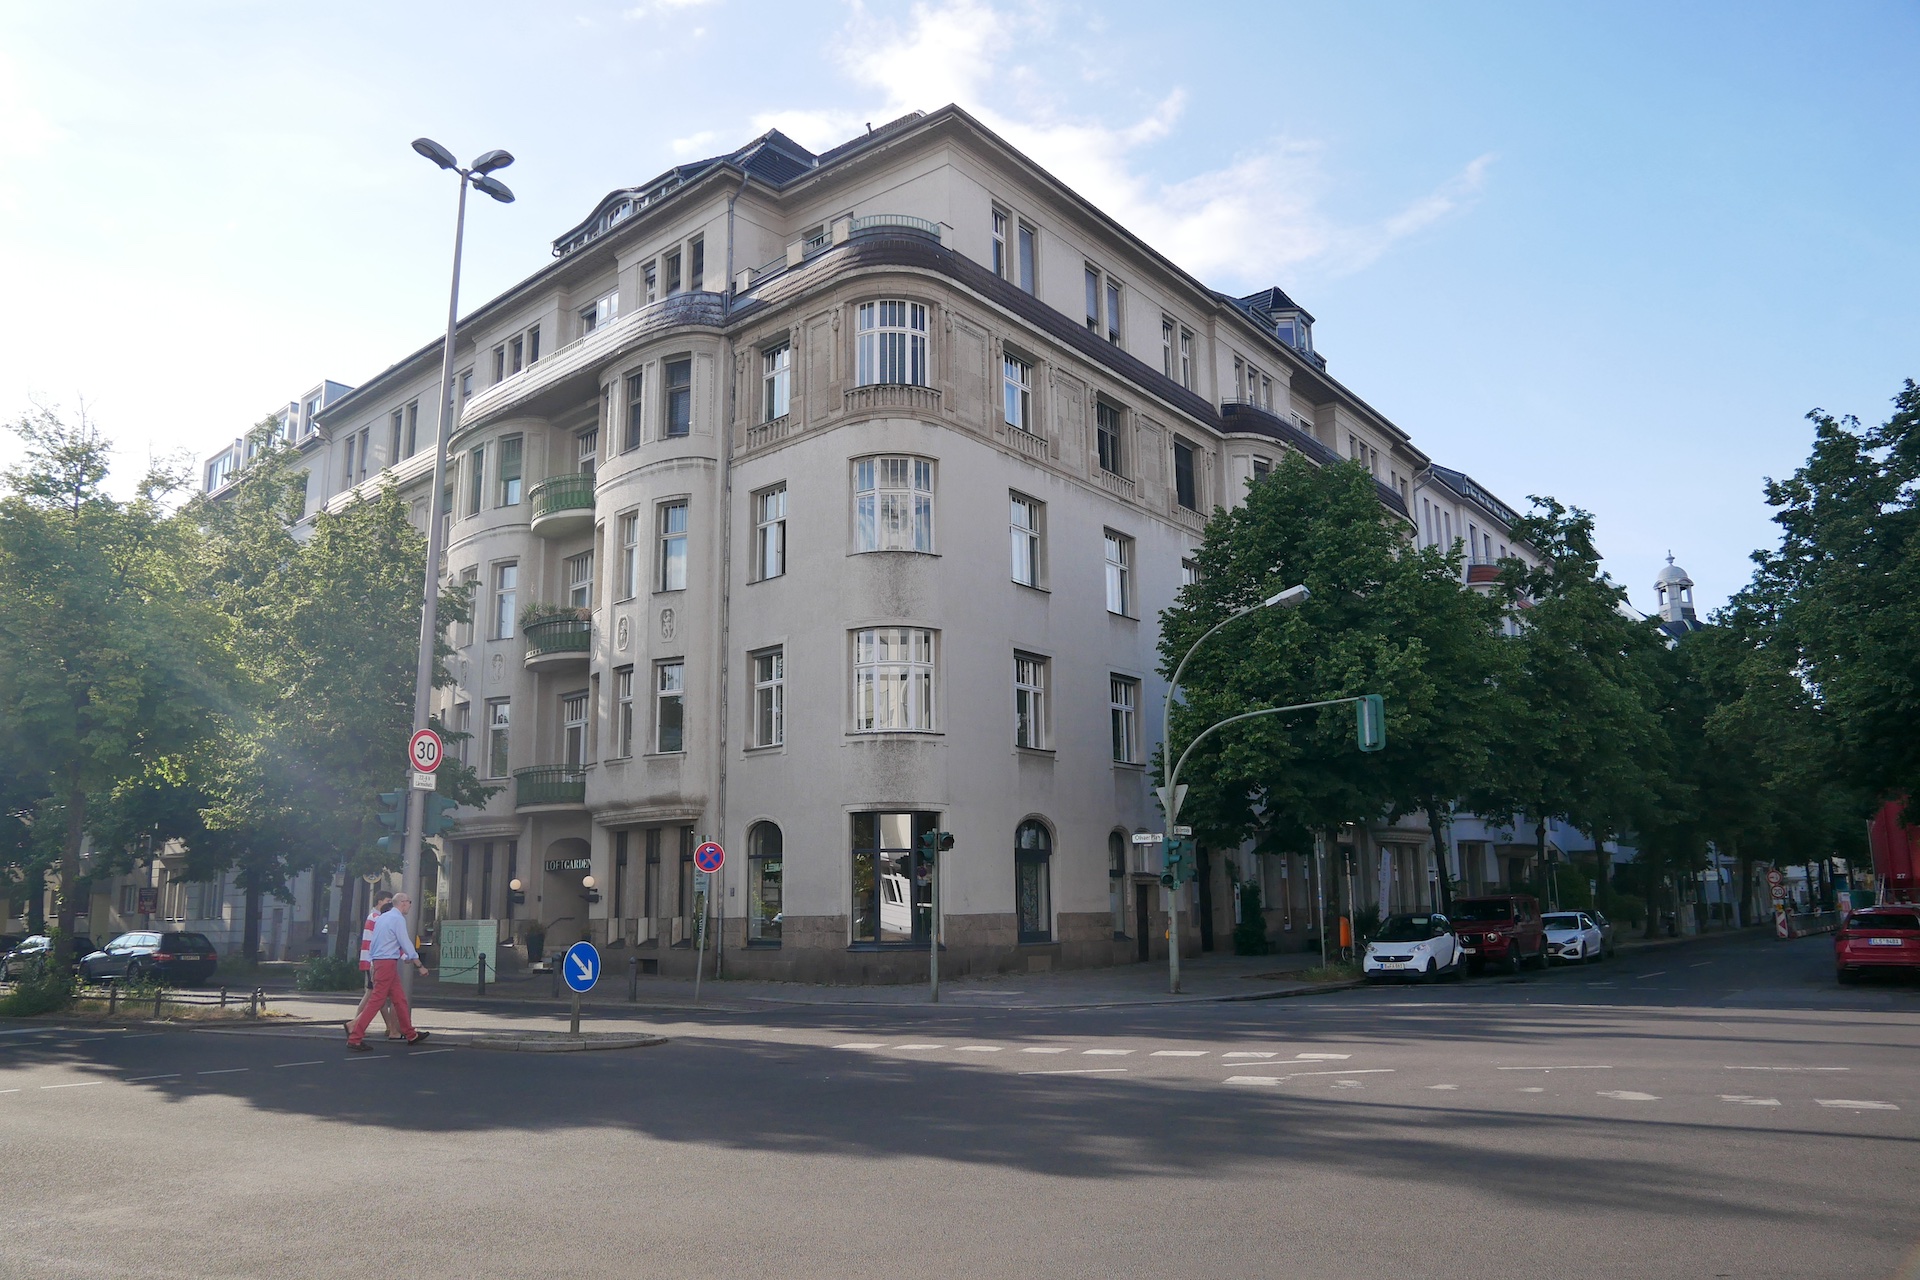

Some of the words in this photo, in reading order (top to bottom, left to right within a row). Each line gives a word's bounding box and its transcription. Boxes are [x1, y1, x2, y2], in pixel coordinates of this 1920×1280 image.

[417, 741, 435, 760] 30
[442, 930, 466, 943] LOFT
[442, 946, 476, 959] GARDEN
